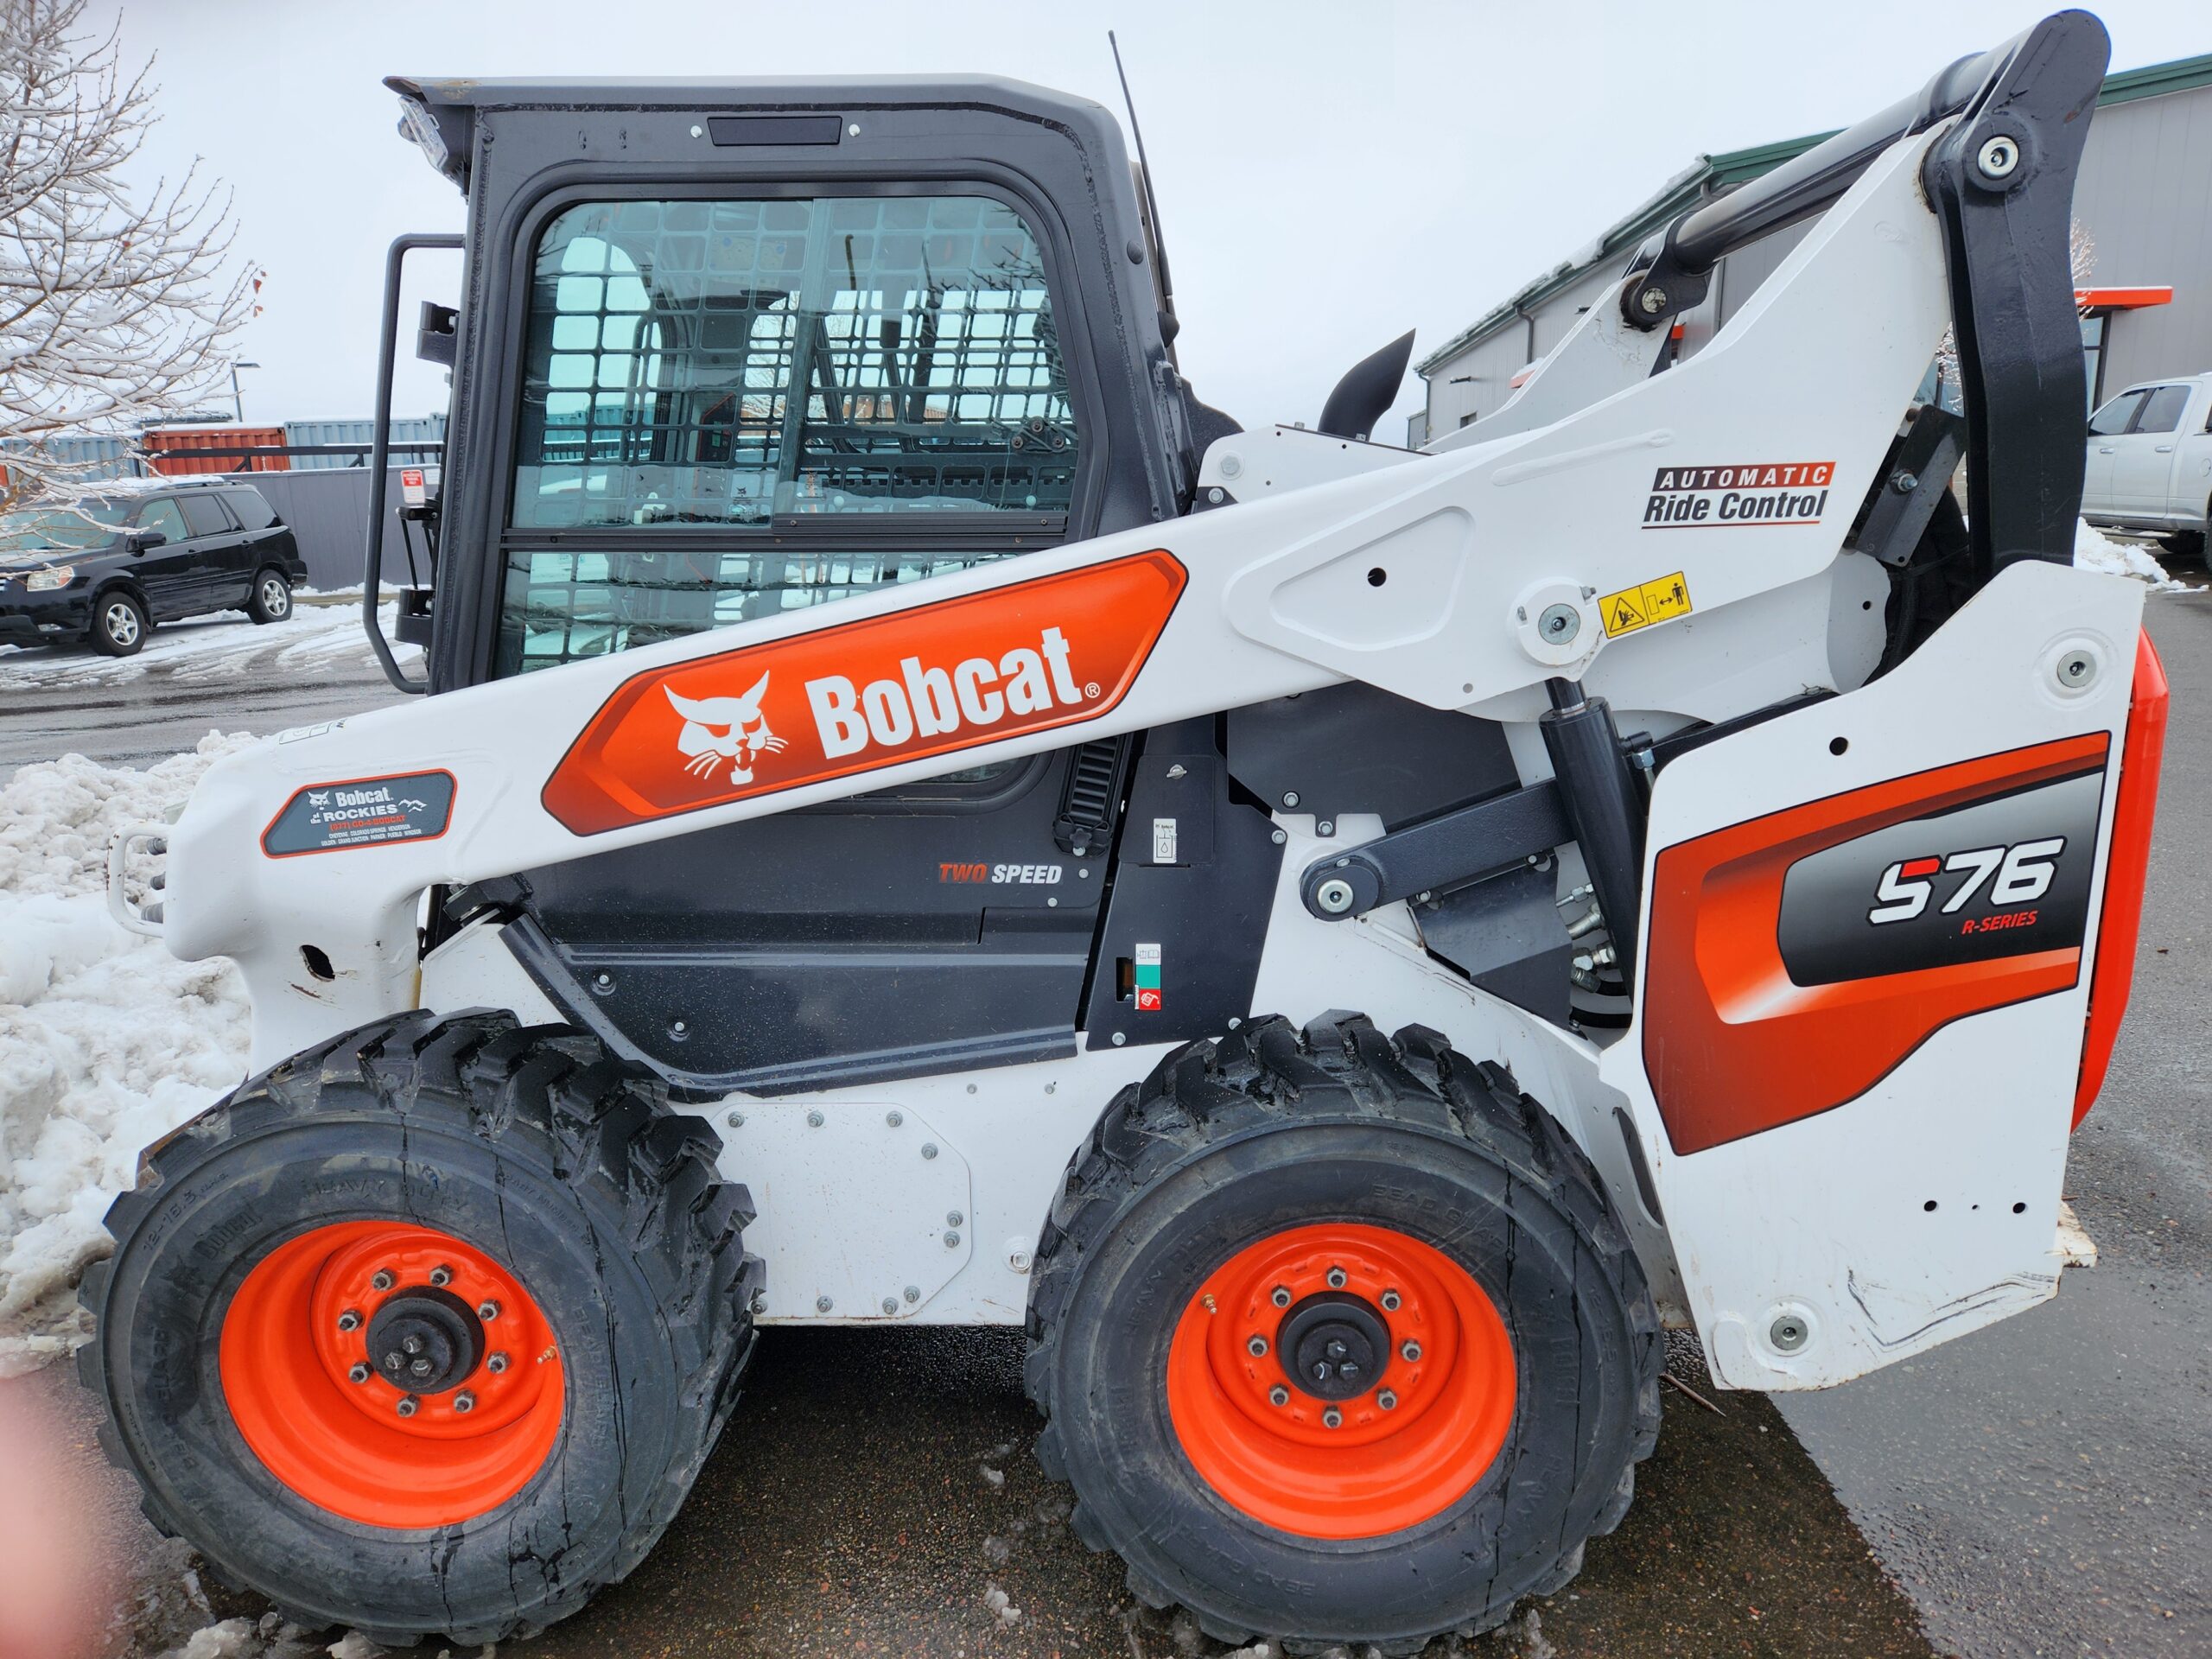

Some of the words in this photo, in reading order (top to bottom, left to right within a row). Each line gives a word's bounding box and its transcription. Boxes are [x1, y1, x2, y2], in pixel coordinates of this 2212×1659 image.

[1659, 466, 1828, 490] AUTOMATIC
[1643, 494, 1711, 522] Ride
[1719, 489, 1828, 520] Control
[805, 626, 1083, 760] Bobcat
[335, 786, 391, 807] Bobcat
[322, 804, 398, 823] ROCKIES
[938, 863, 988, 883] TWO
[991, 864, 1063, 884] SPEED
[1866, 835, 2068, 927] S76
[1961, 910, 2037, 934] R-SERIES
